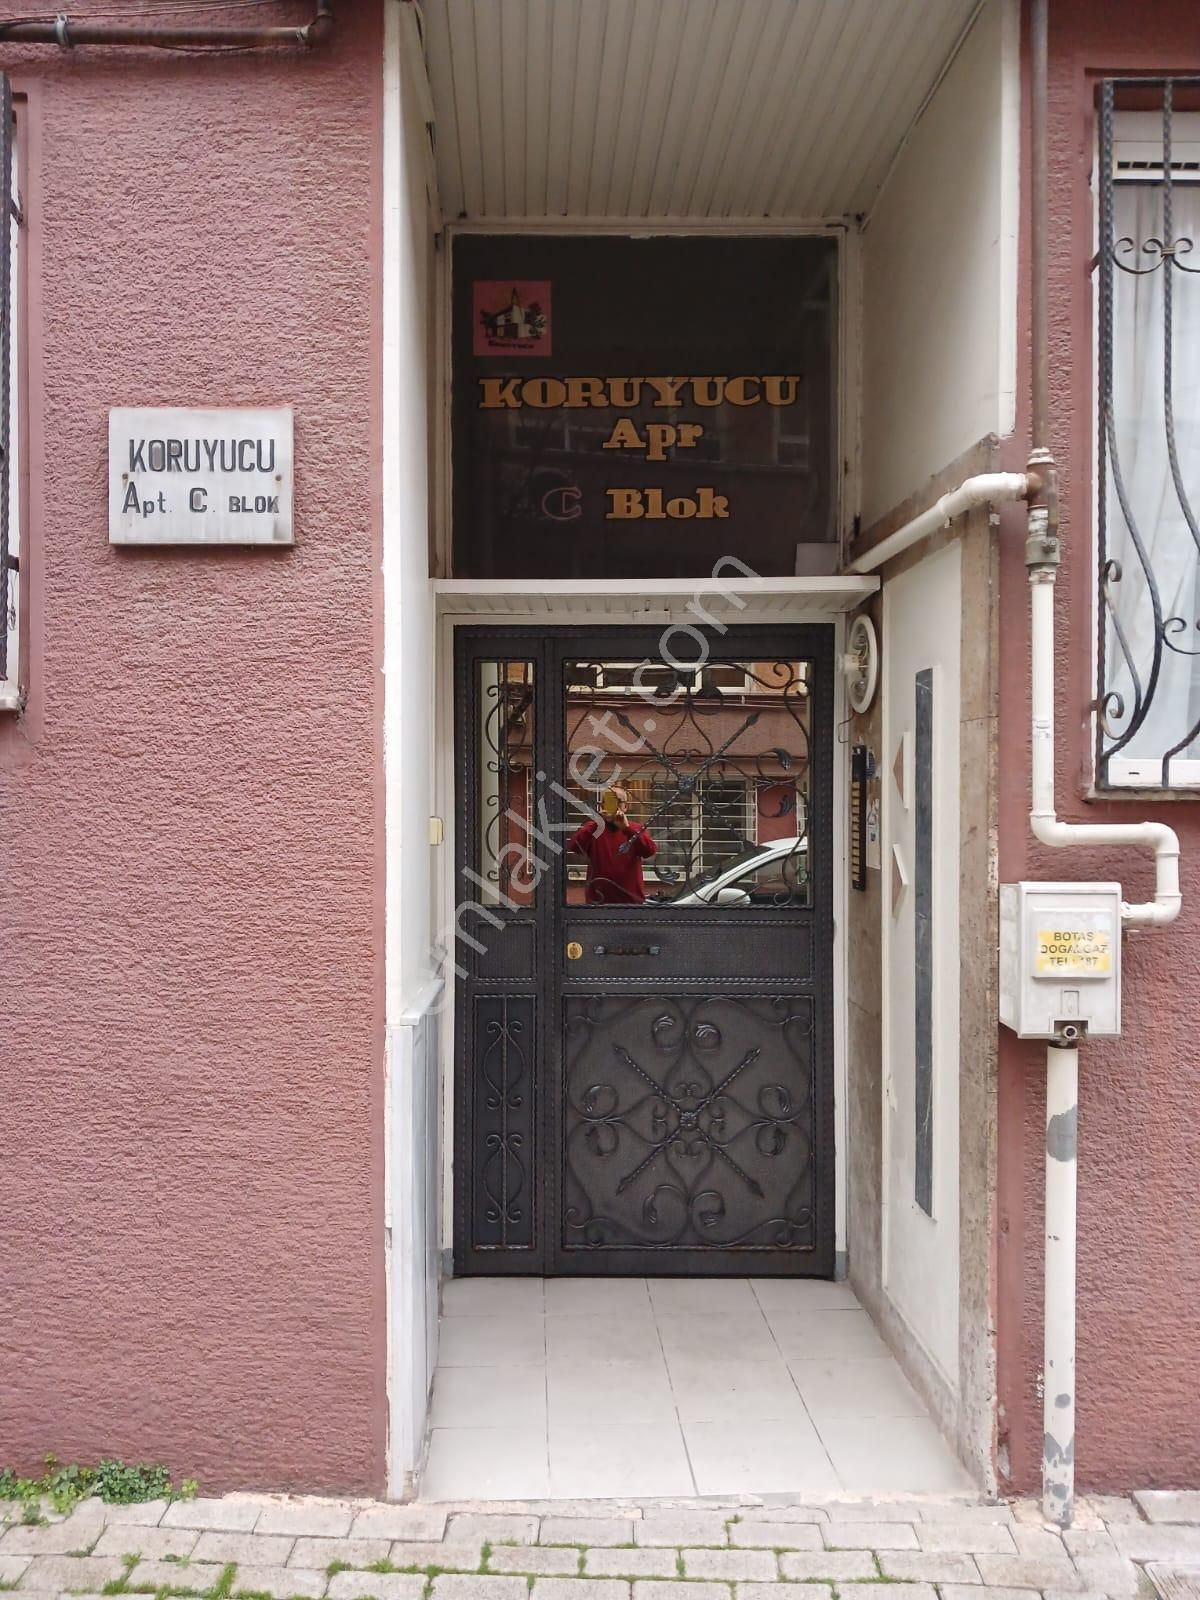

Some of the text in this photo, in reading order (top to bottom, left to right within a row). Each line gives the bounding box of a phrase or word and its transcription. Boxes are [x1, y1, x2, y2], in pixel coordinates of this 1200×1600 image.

[479, 375, 800, 408] KORUYUCU
[128, 439, 275, 473] KORUYUCU
[228, 496, 280, 514] BLOK
[606, 487, 730, 519] Blok
